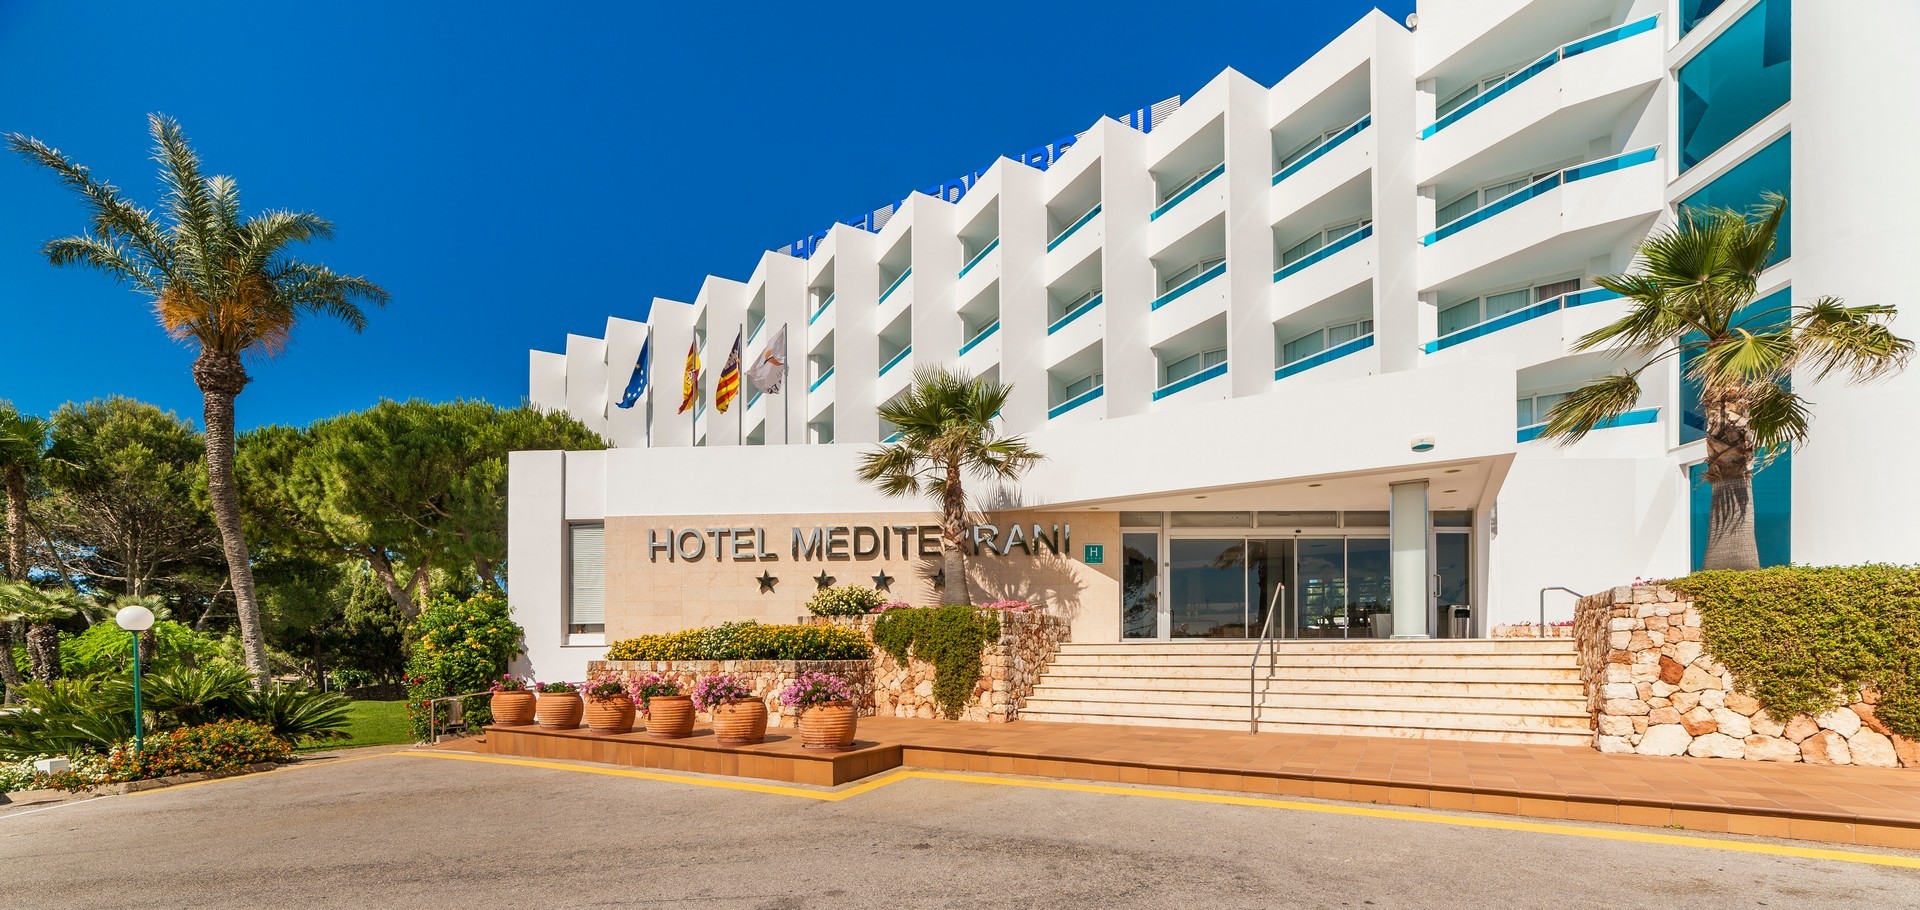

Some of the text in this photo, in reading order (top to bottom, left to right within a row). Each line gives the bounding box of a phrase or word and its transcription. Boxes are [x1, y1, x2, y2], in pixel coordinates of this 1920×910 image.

[648, 524, 1071, 560] HOTEL MEDITERANI
[1090, 546, 1098, 557] H
